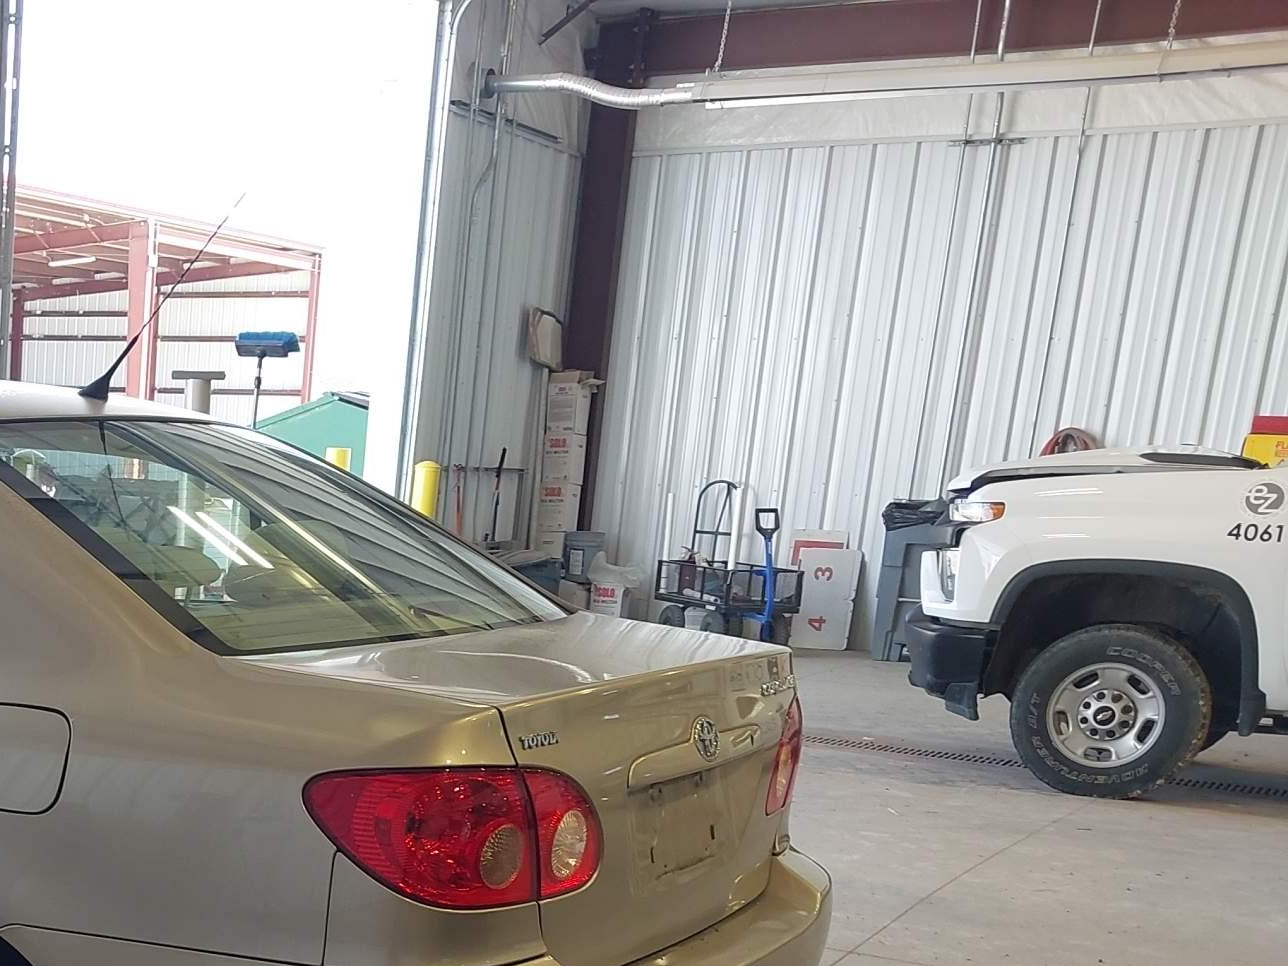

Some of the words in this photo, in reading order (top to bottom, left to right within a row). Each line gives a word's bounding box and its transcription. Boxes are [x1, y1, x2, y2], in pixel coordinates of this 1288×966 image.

[1226, 522, 1285, 543] 4061
[814, 566, 834, 582] 3
[807, 615, 827, 632] 4
[1106, 646, 1183, 697] COOPER
